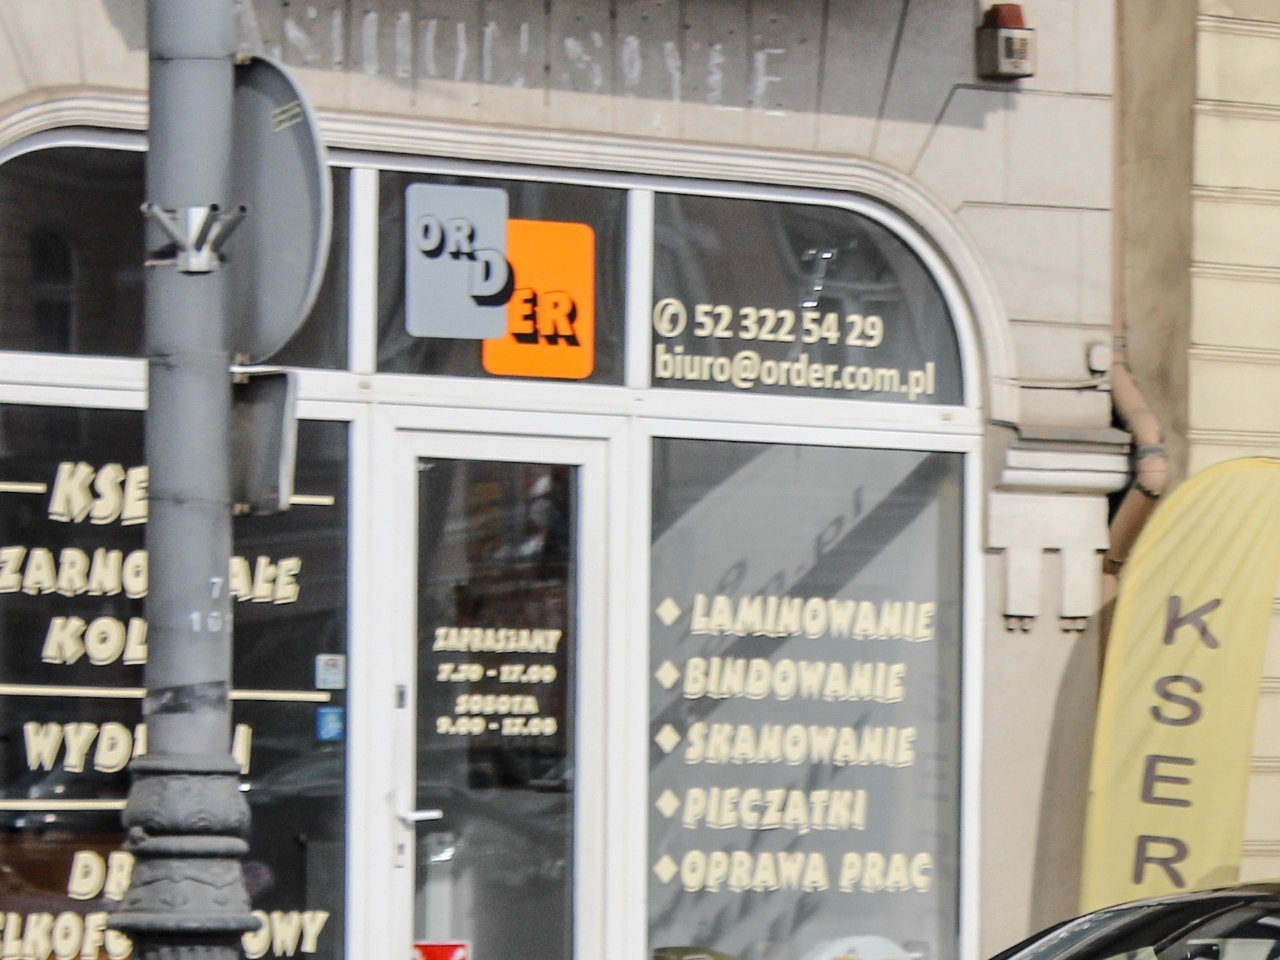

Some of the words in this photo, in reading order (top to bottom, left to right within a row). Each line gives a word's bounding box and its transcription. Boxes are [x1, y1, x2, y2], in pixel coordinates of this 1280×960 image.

[693, 303, 734, 339] 52
[738, 306, 797, 343] 322
[802, 311, 841, 345] 54
[845, 313, 885, 348] 29
[655, 343, 936, 401] biuro@order.com.pl
[690, 593, 937, 642] LAMINOWANIE
[683, 656, 907, 704] BINDOWANIE
[685, 722, 917, 768] SKANOWANIE
[1132, 595, 1222, 890] KSER
[682, 786, 868, 835] PIECZĄTKI
[680, 850, 830, 893] OPRAWA
[838, 851, 934, 893] PRAC
